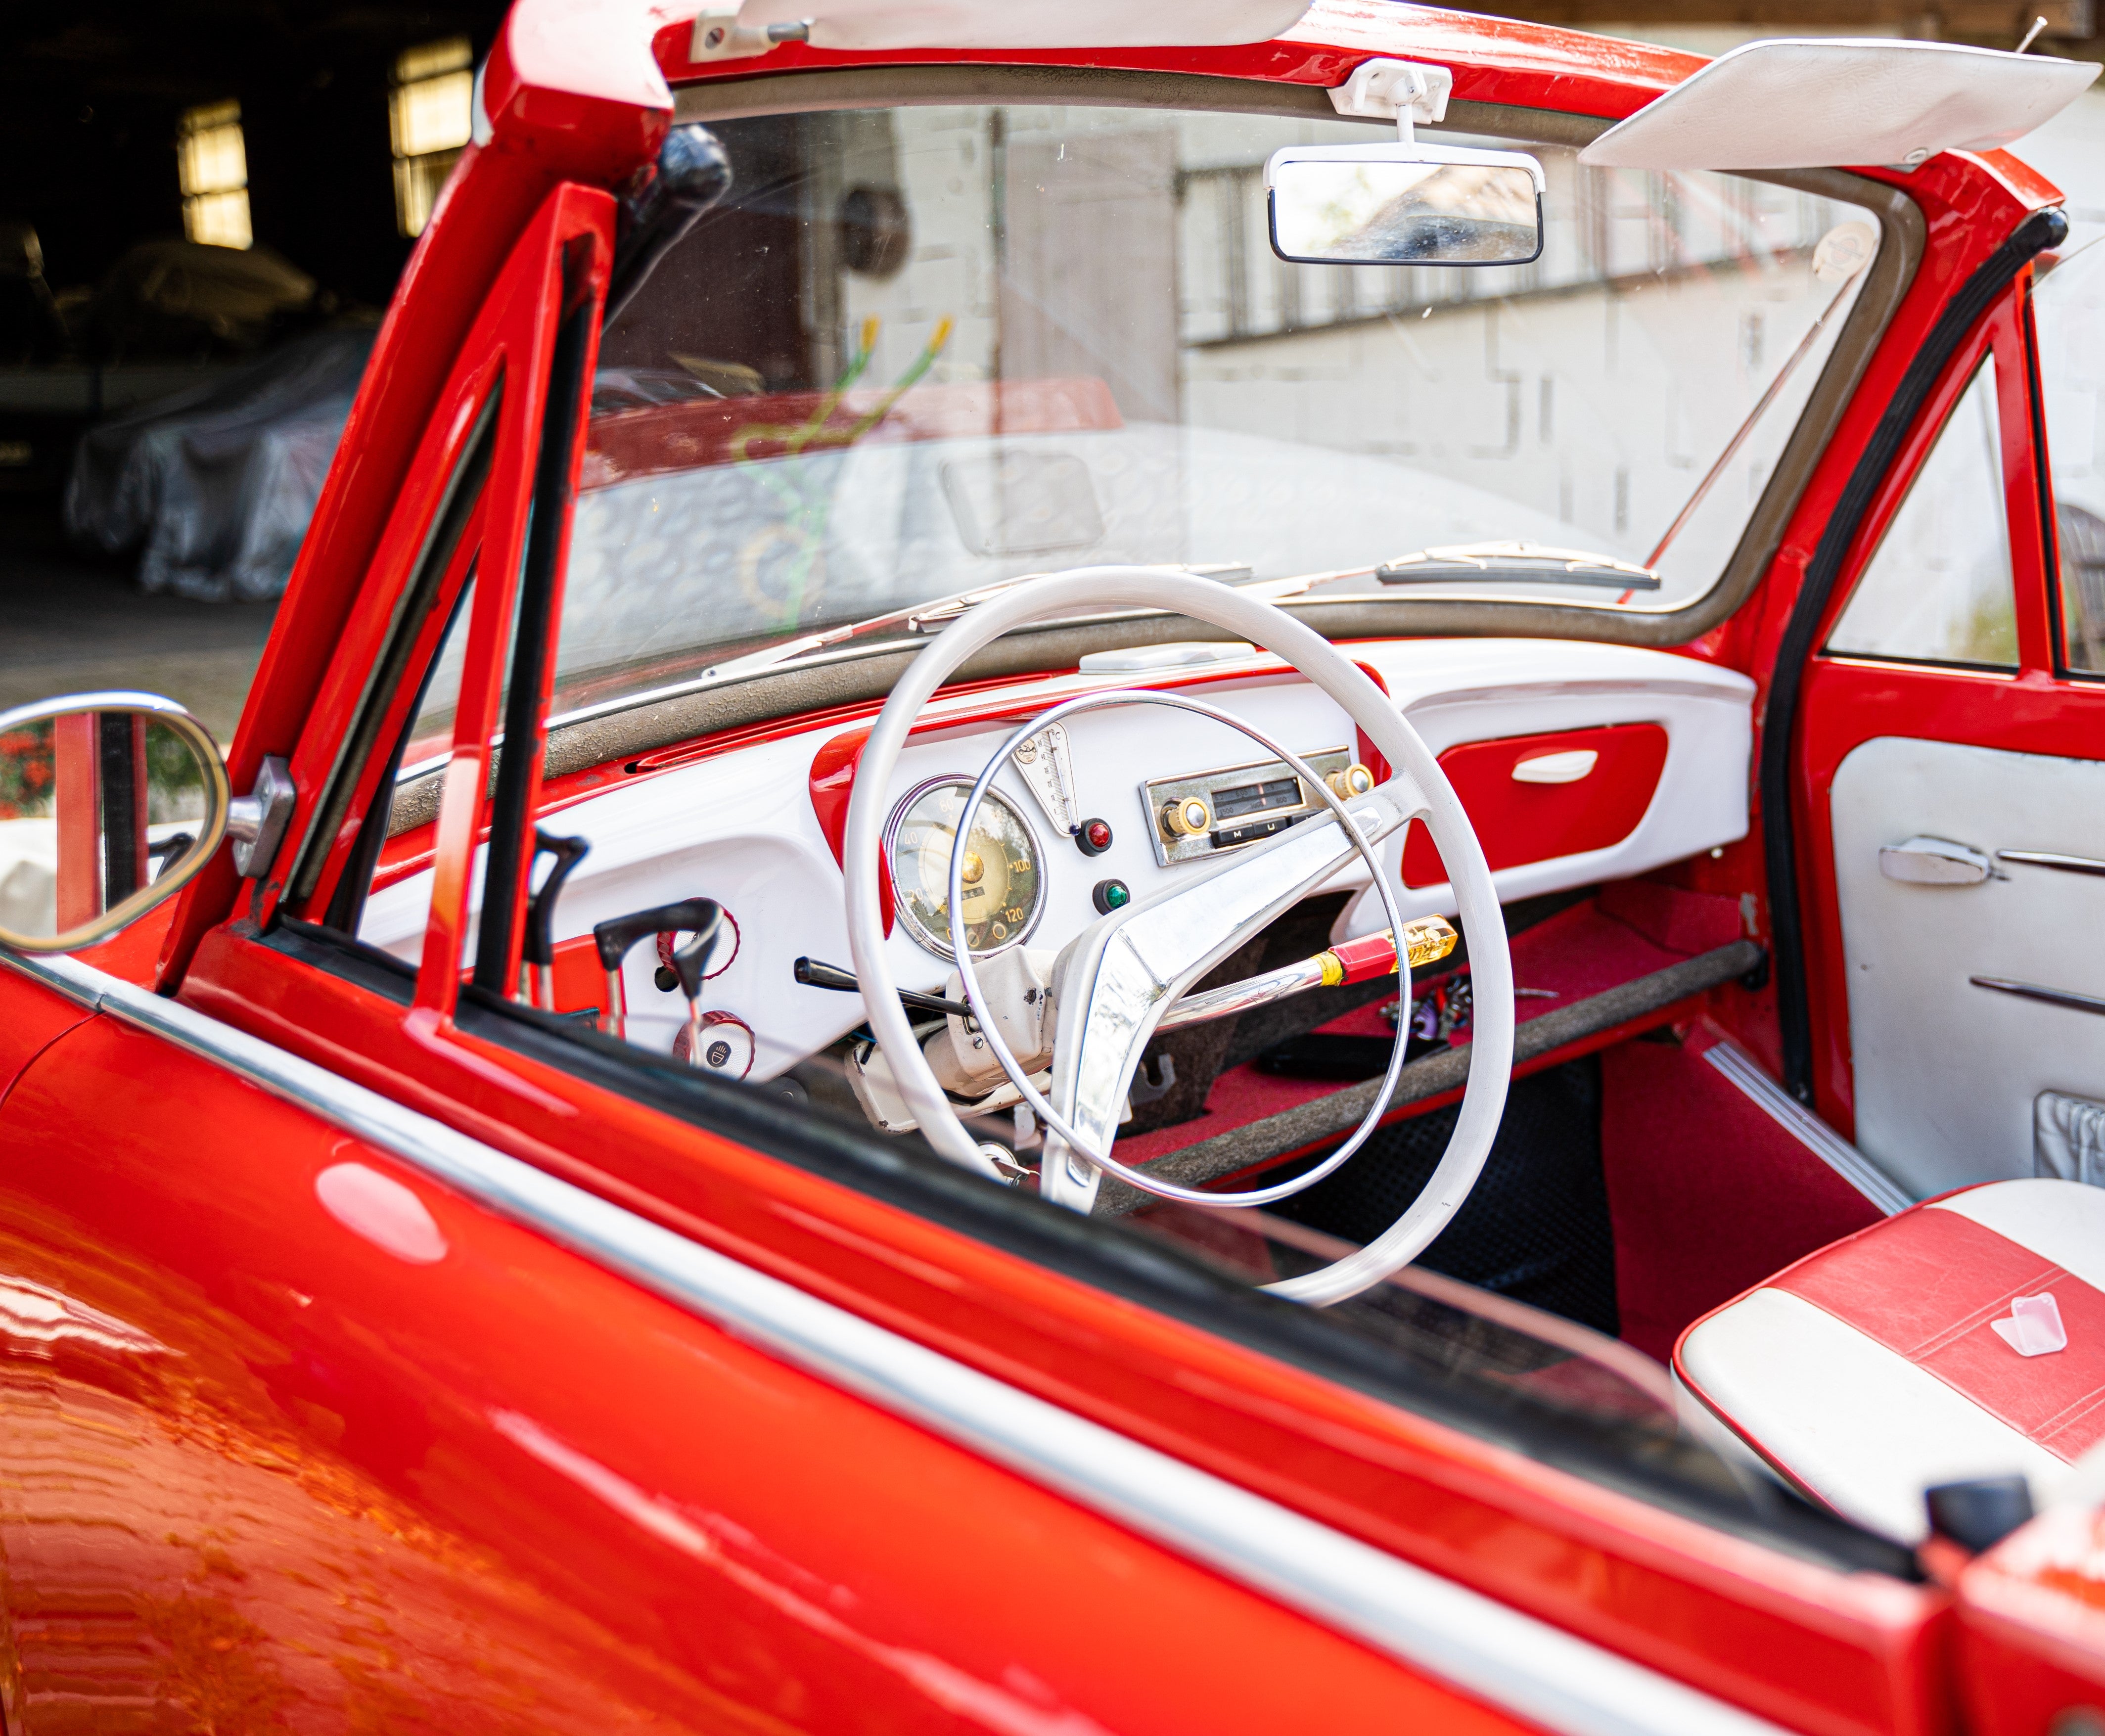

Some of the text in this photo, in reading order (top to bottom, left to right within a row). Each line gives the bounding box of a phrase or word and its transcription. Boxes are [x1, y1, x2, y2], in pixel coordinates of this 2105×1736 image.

[940, 798, 954, 813] 60
[1267, 822, 1276, 831] U
[905, 831, 918, 845] 40
[1013, 859, 1031, 873] 100
[908, 887, 923, 903] 20
[1005, 907, 1024, 923] 120
